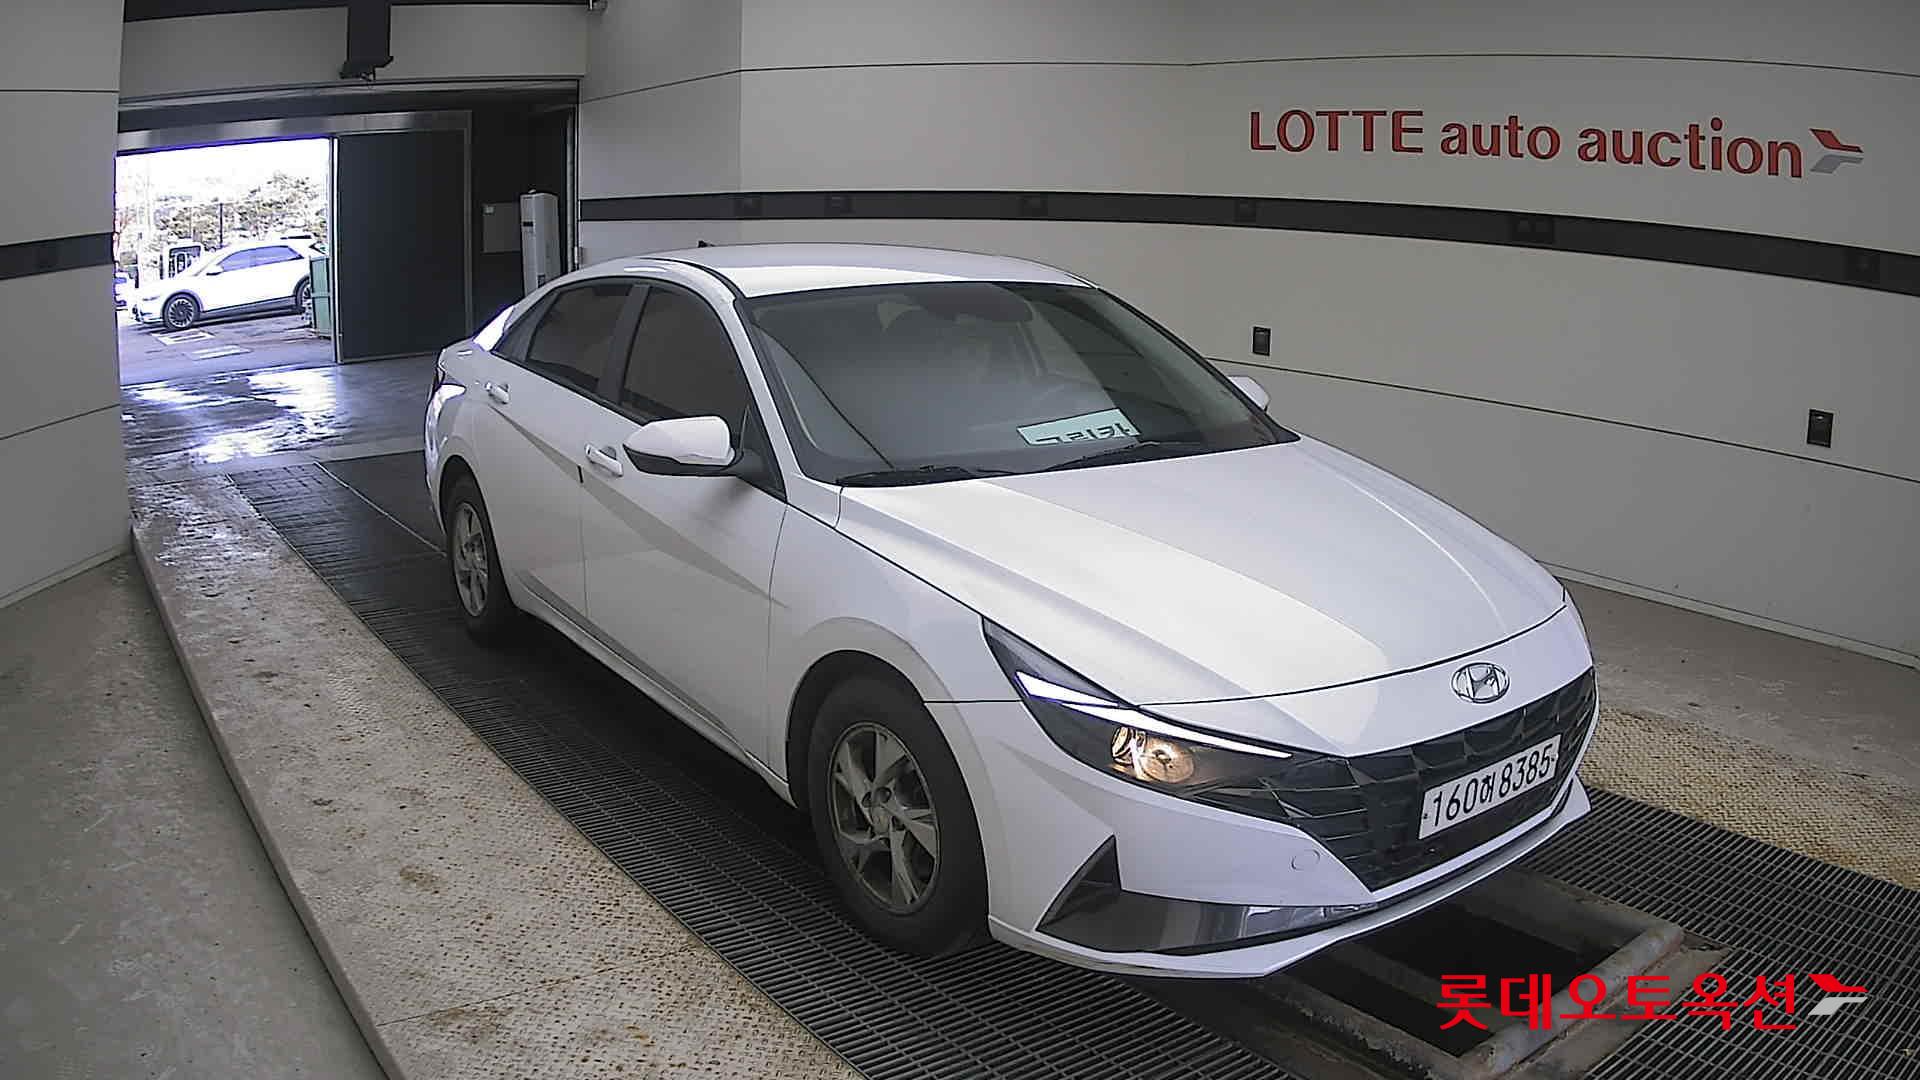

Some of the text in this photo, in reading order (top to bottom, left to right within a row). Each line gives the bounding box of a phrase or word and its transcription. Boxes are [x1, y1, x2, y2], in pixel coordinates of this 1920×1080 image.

[1249, 110, 1803, 179] LOTTE auto auction
